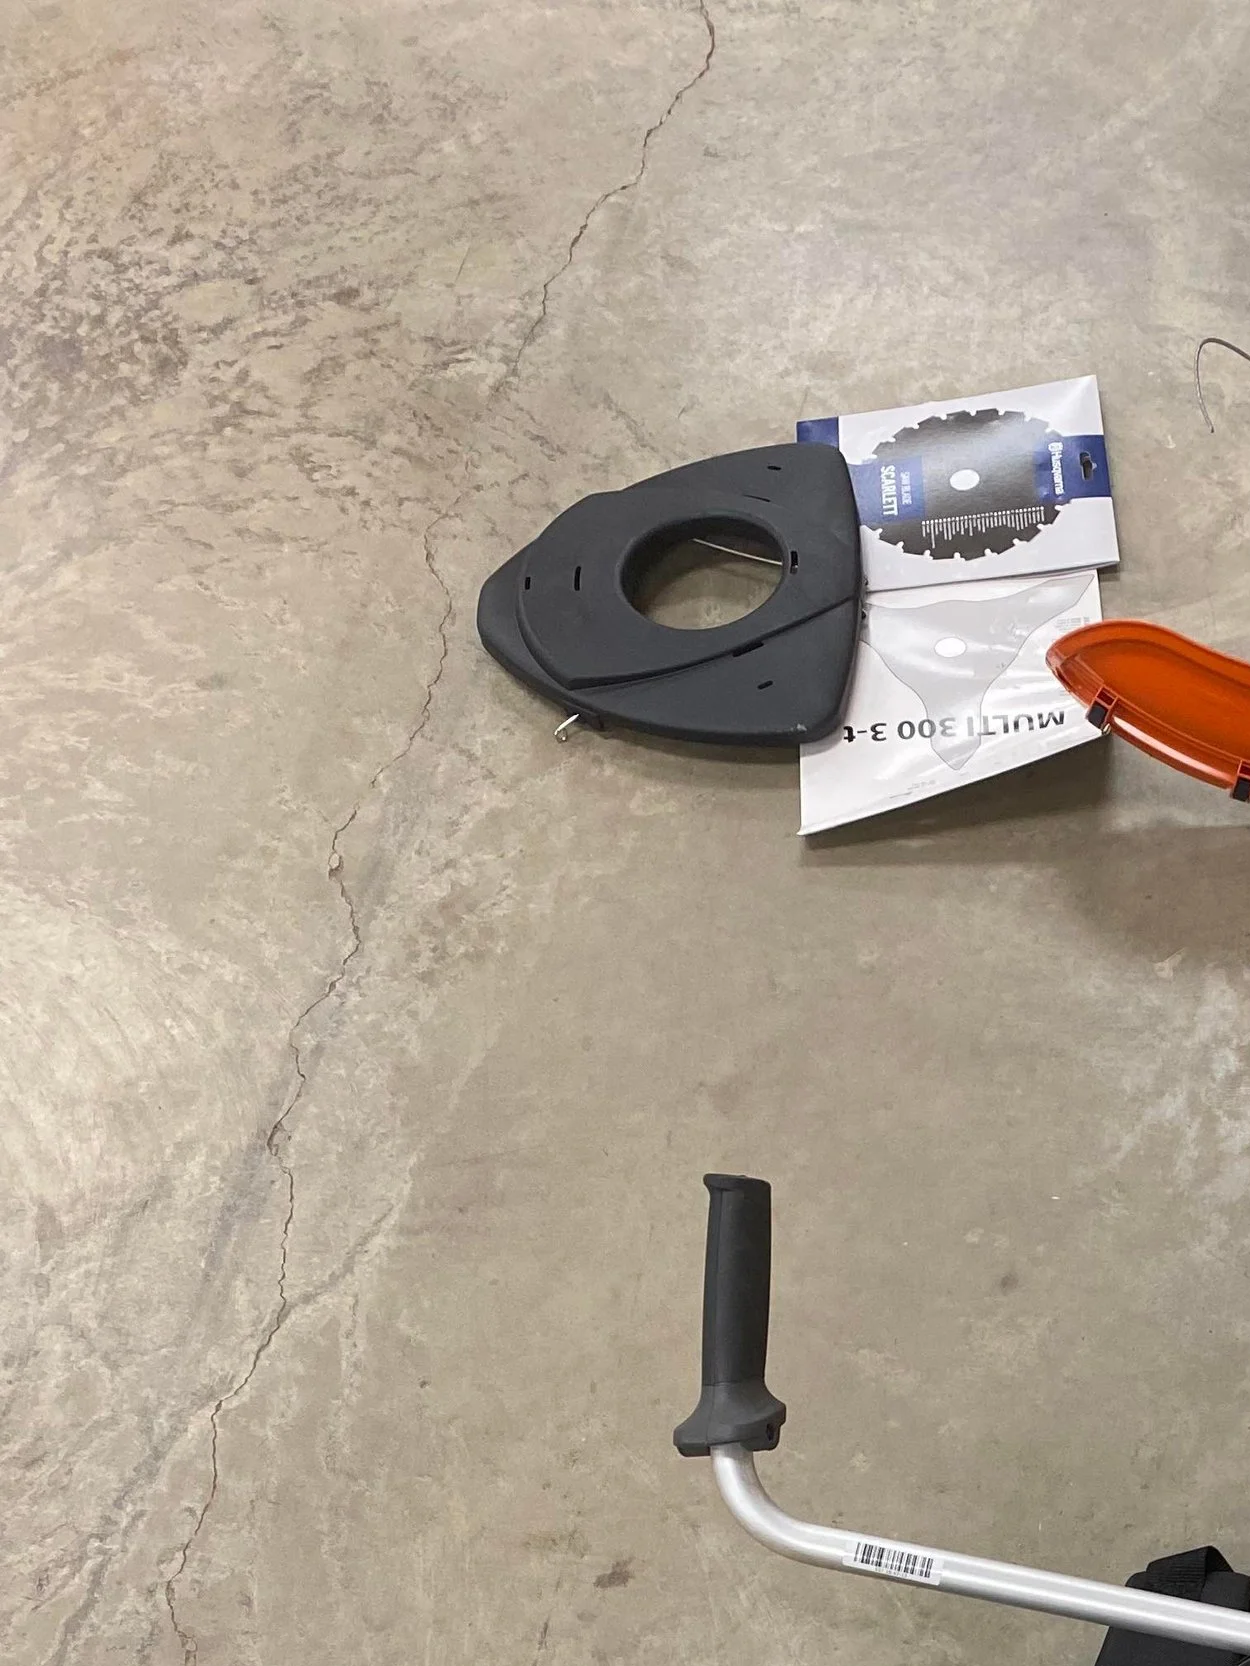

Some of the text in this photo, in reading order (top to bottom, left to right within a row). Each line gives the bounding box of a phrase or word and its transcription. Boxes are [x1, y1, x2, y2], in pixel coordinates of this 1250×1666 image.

[880, 465, 898, 516] SCARLETT
[1051, 451, 1064, 495] Husqvarna
[843, 711, 1065, 744] MULTI 300 3-t
